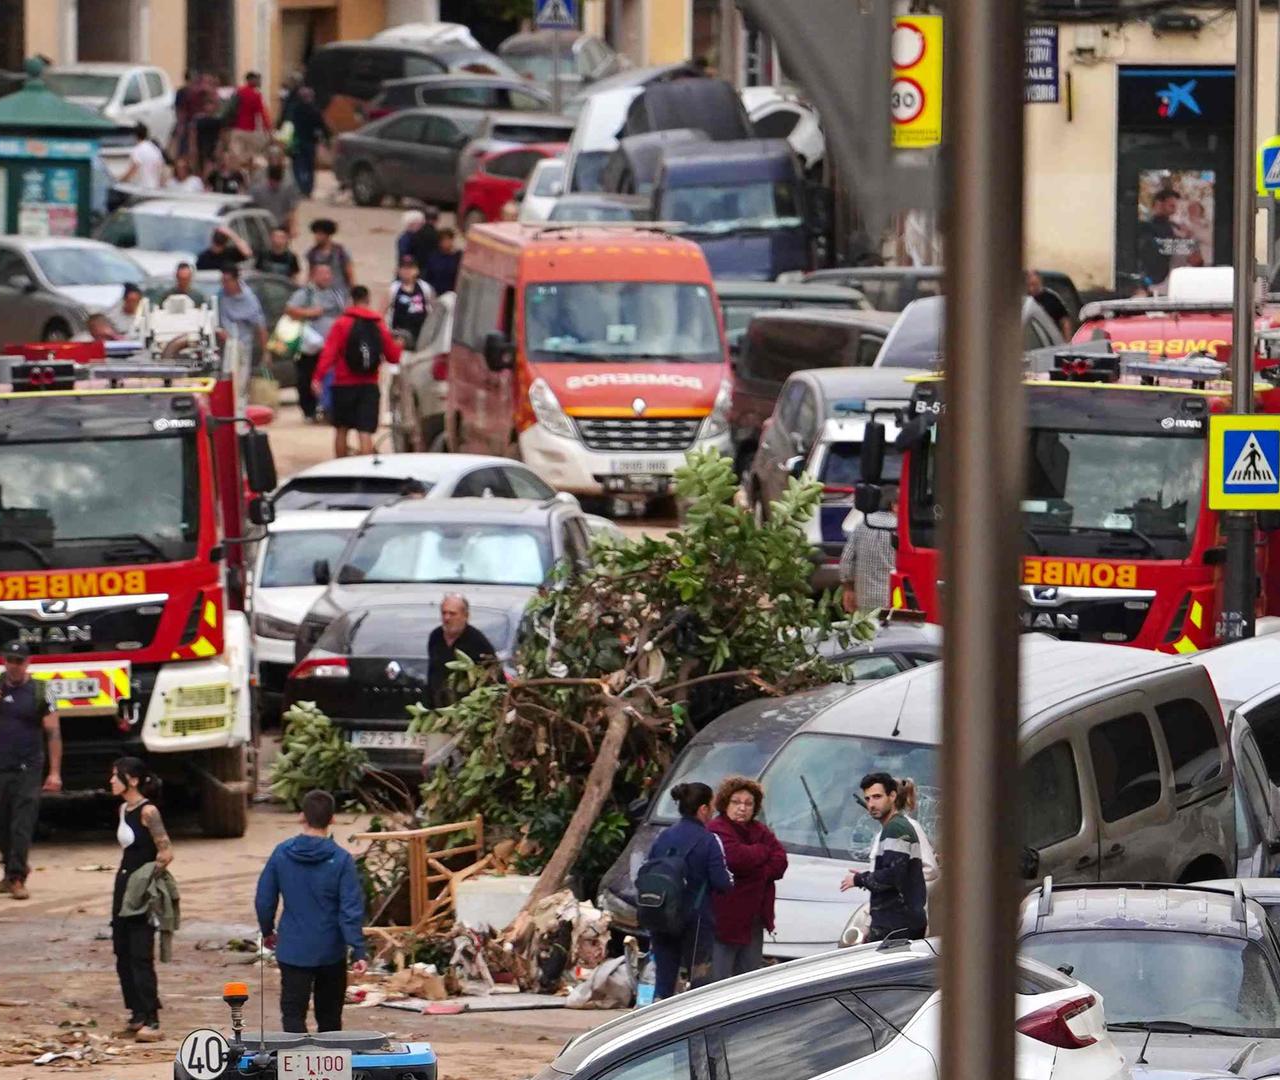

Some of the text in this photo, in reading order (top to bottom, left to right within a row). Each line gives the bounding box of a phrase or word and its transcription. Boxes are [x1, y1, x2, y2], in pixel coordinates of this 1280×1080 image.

[19, 625, 92, 642] MAN
[188, 1036, 222, 1074] 40
[284, 1056, 344, 1072] E 1100
